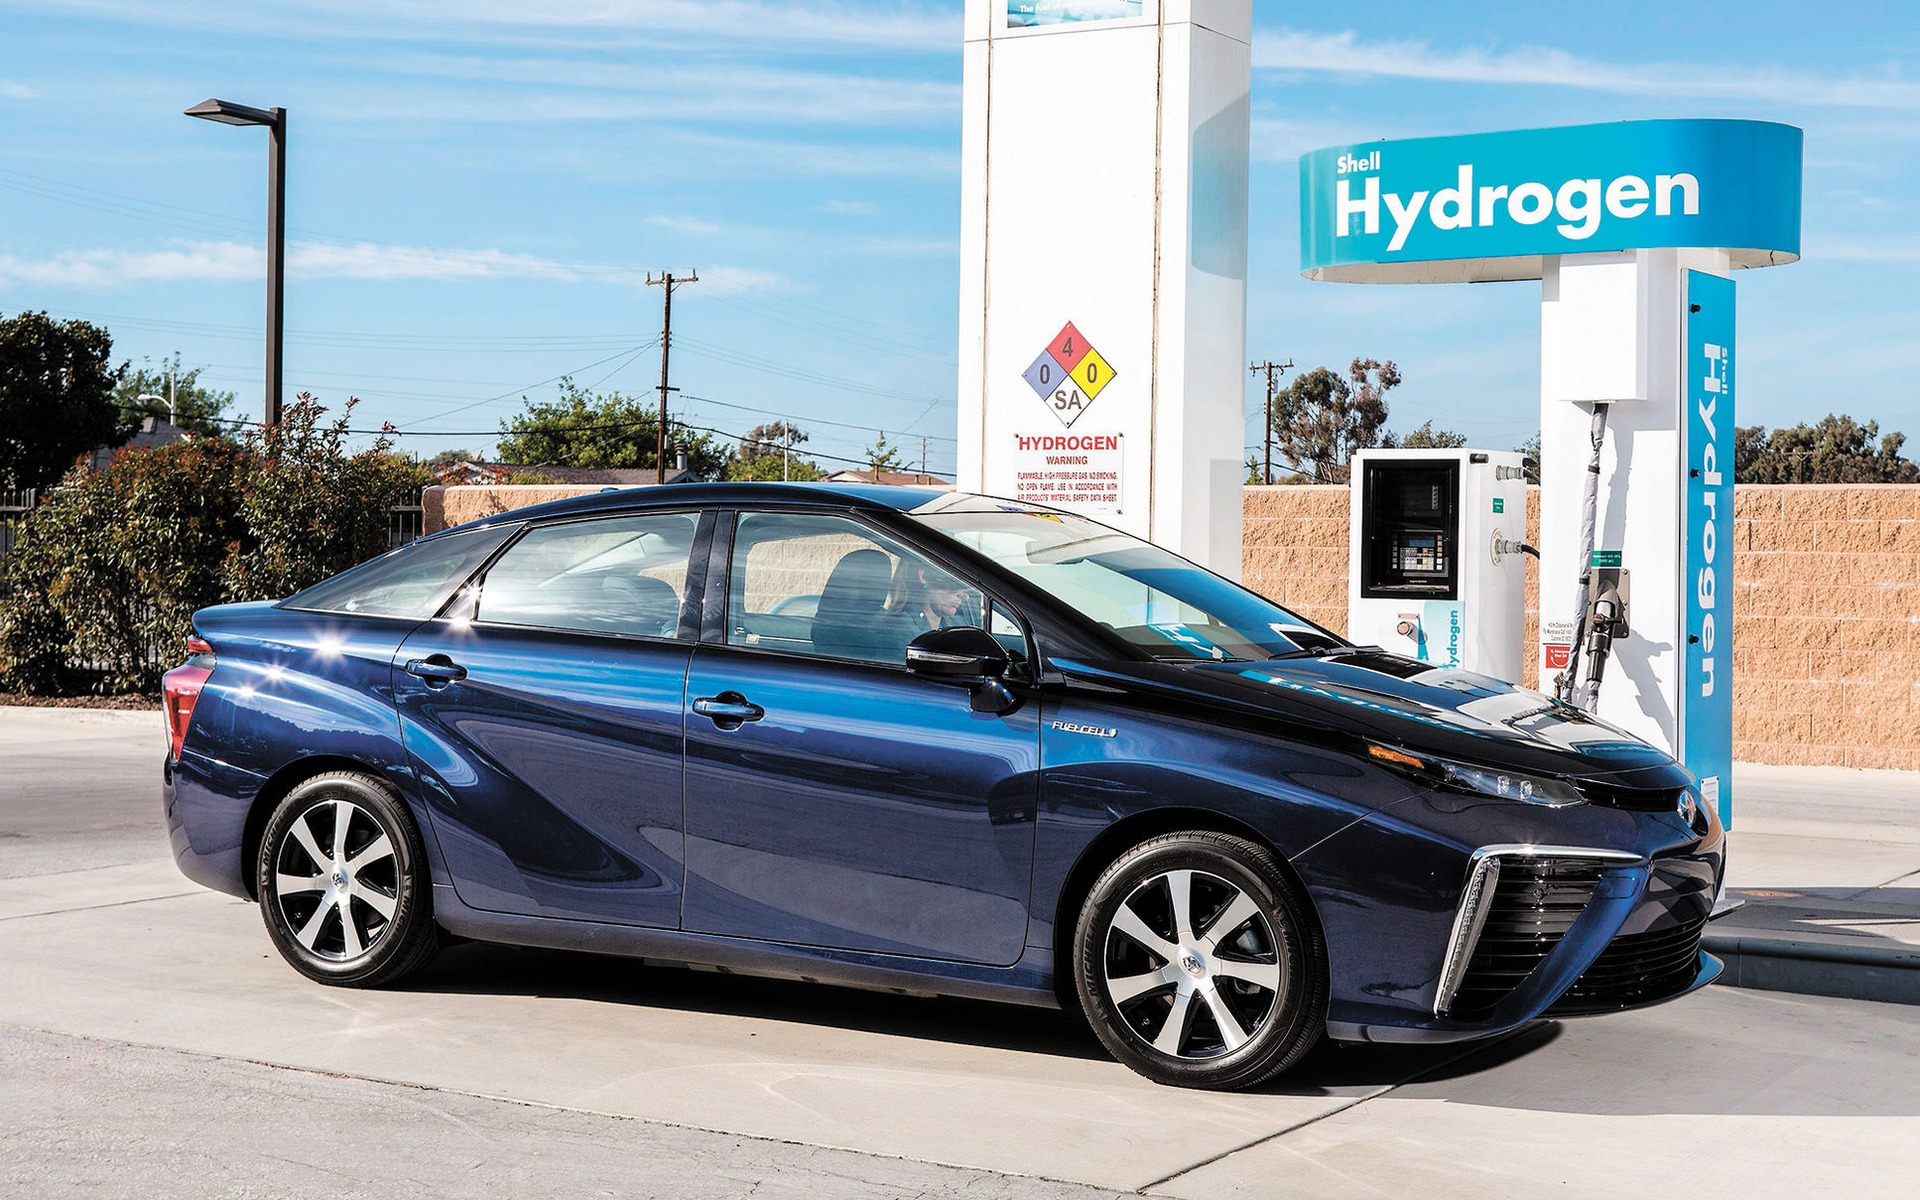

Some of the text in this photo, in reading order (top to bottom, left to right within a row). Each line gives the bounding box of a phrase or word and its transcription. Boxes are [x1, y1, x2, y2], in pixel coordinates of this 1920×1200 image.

[1337, 150, 1381, 174] Shell
[1335, 164, 1699, 252] Hydrogen
[1062, 337, 1074, 357] 4
[1039, 363, 1050, 385] 0
[1087, 362, 1098, 384] 0
[1054, 389, 1082, 410] SA
[1018, 435, 1118, 451] HYDROGEN
[1046, 455, 1089, 465] WARNING
[1044, 472, 1055, 480] HIGH
[1056, 472, 1078, 480] PRESSURE
[1089, 472, 1095, 480] NO
[1017, 483, 1024, 491] NO
[1026, 483, 1038, 491] OPEN
[1057, 483, 1066, 491] USE
[1068, 483, 1073, 491] IN
[1075, 483, 1104, 491] ACCORDANCE
[1106, 483, 1118, 491] WITH
[1072, 494, 1089, 502] SAFETY
[1090, 494, 1102, 502] DATA
[1698, 342, 1722, 698] Hydrogen
